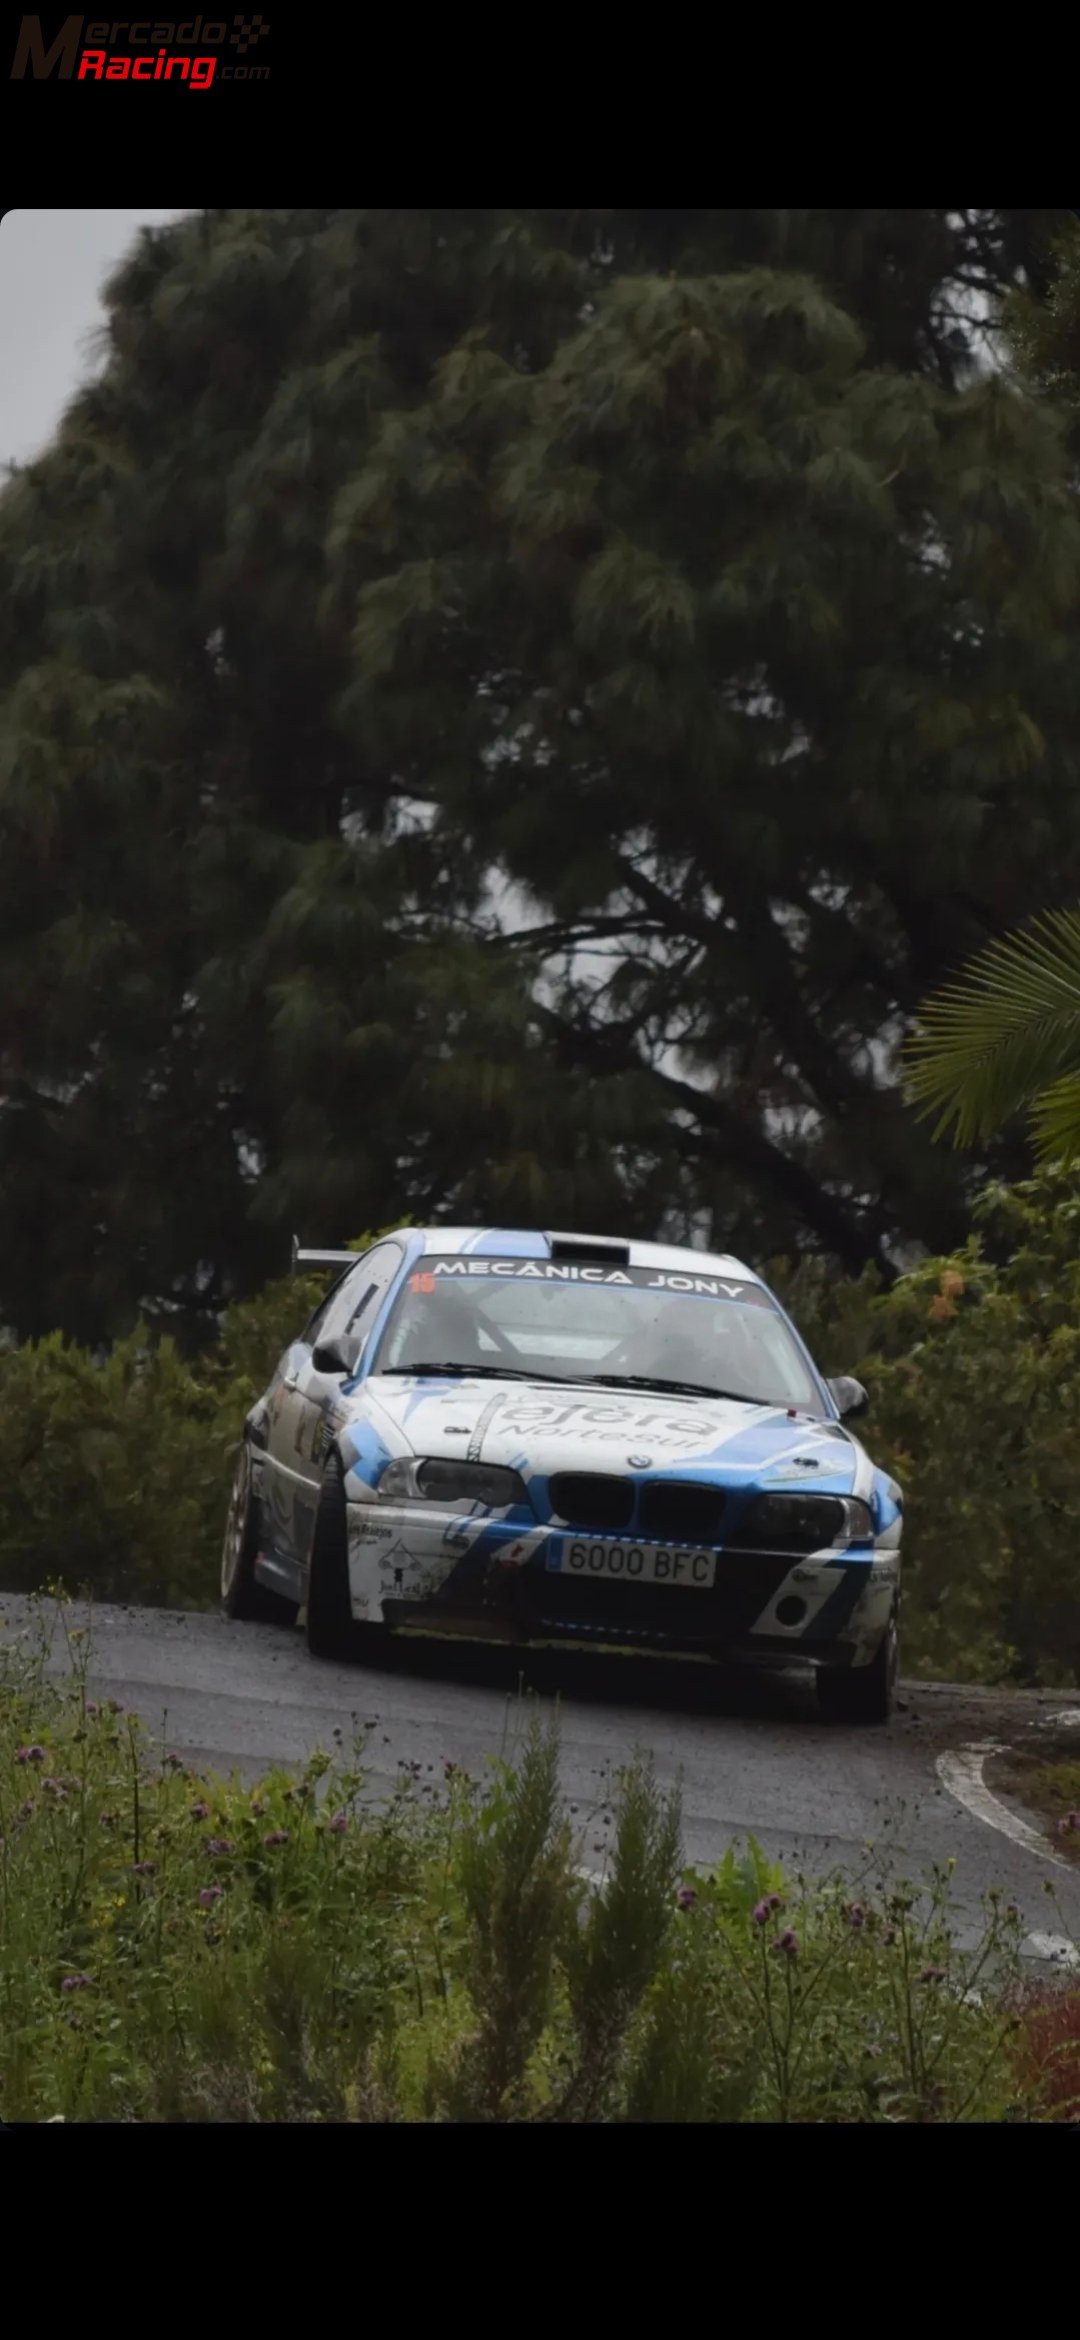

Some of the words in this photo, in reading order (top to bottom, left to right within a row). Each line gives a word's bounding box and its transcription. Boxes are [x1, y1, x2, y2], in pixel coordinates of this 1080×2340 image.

[434, 1261, 634, 1285] MECÁNICA
[648, 1274, 745, 1298] JONY
[569, 1543, 644, 1575] 6000
[654, 1551, 710, 1582] BFC
